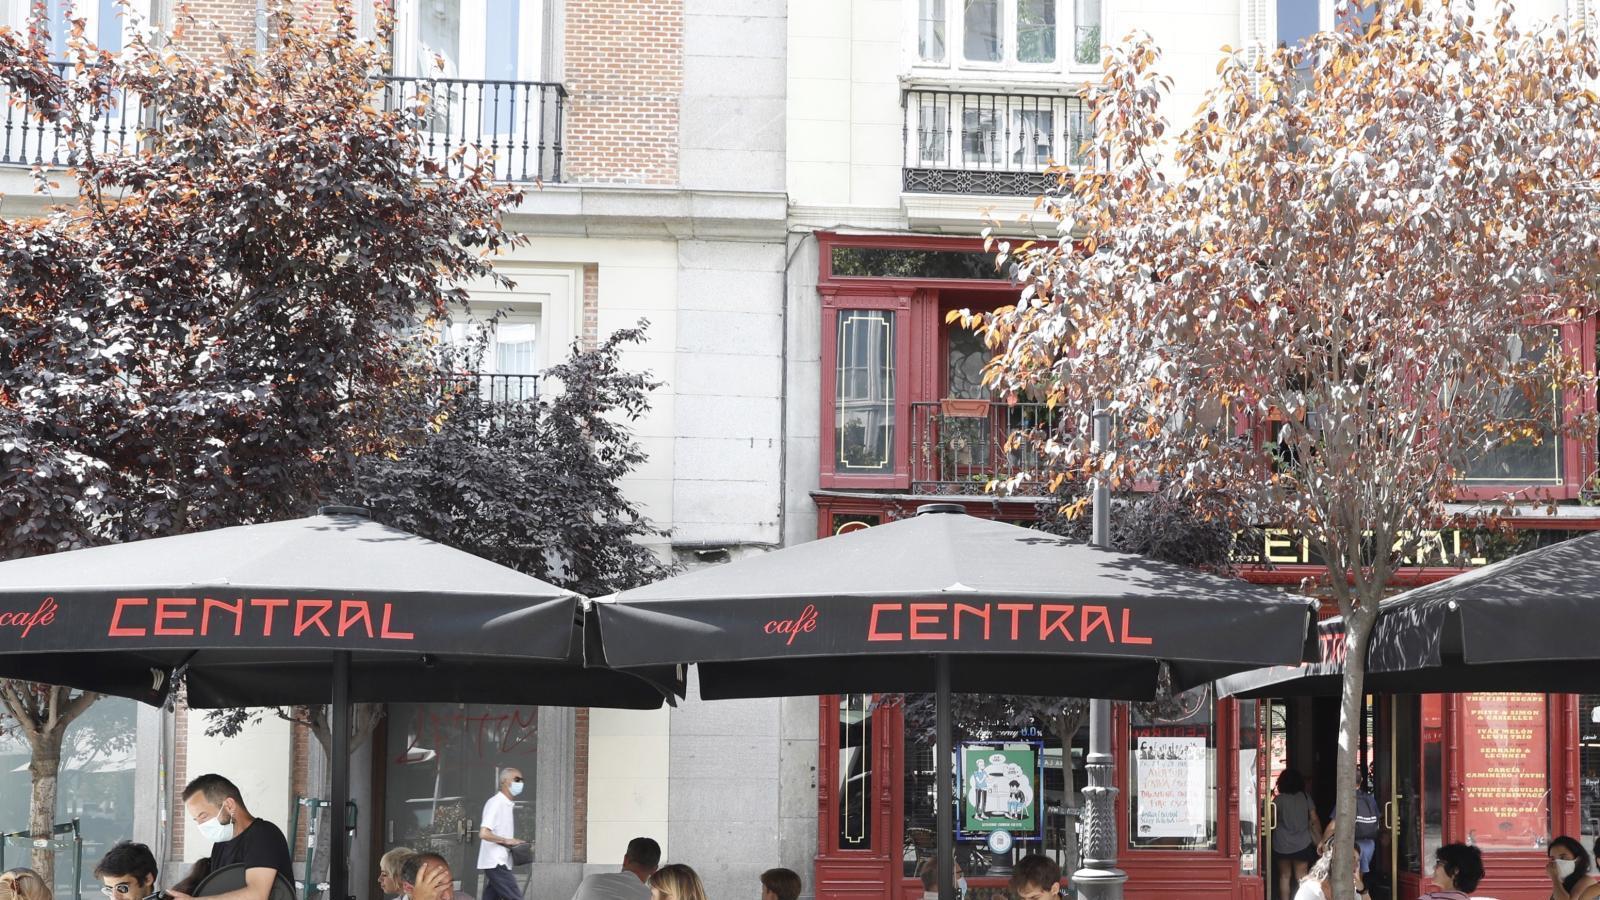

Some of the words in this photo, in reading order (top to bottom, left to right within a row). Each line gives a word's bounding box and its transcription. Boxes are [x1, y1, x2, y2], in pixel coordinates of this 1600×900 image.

[0, 597, 58, 638] café
[108, 598, 414, 640] CENTRAL
[763, 604, 818, 645] café
[867, 603, 1153, 645] CENTRAL
